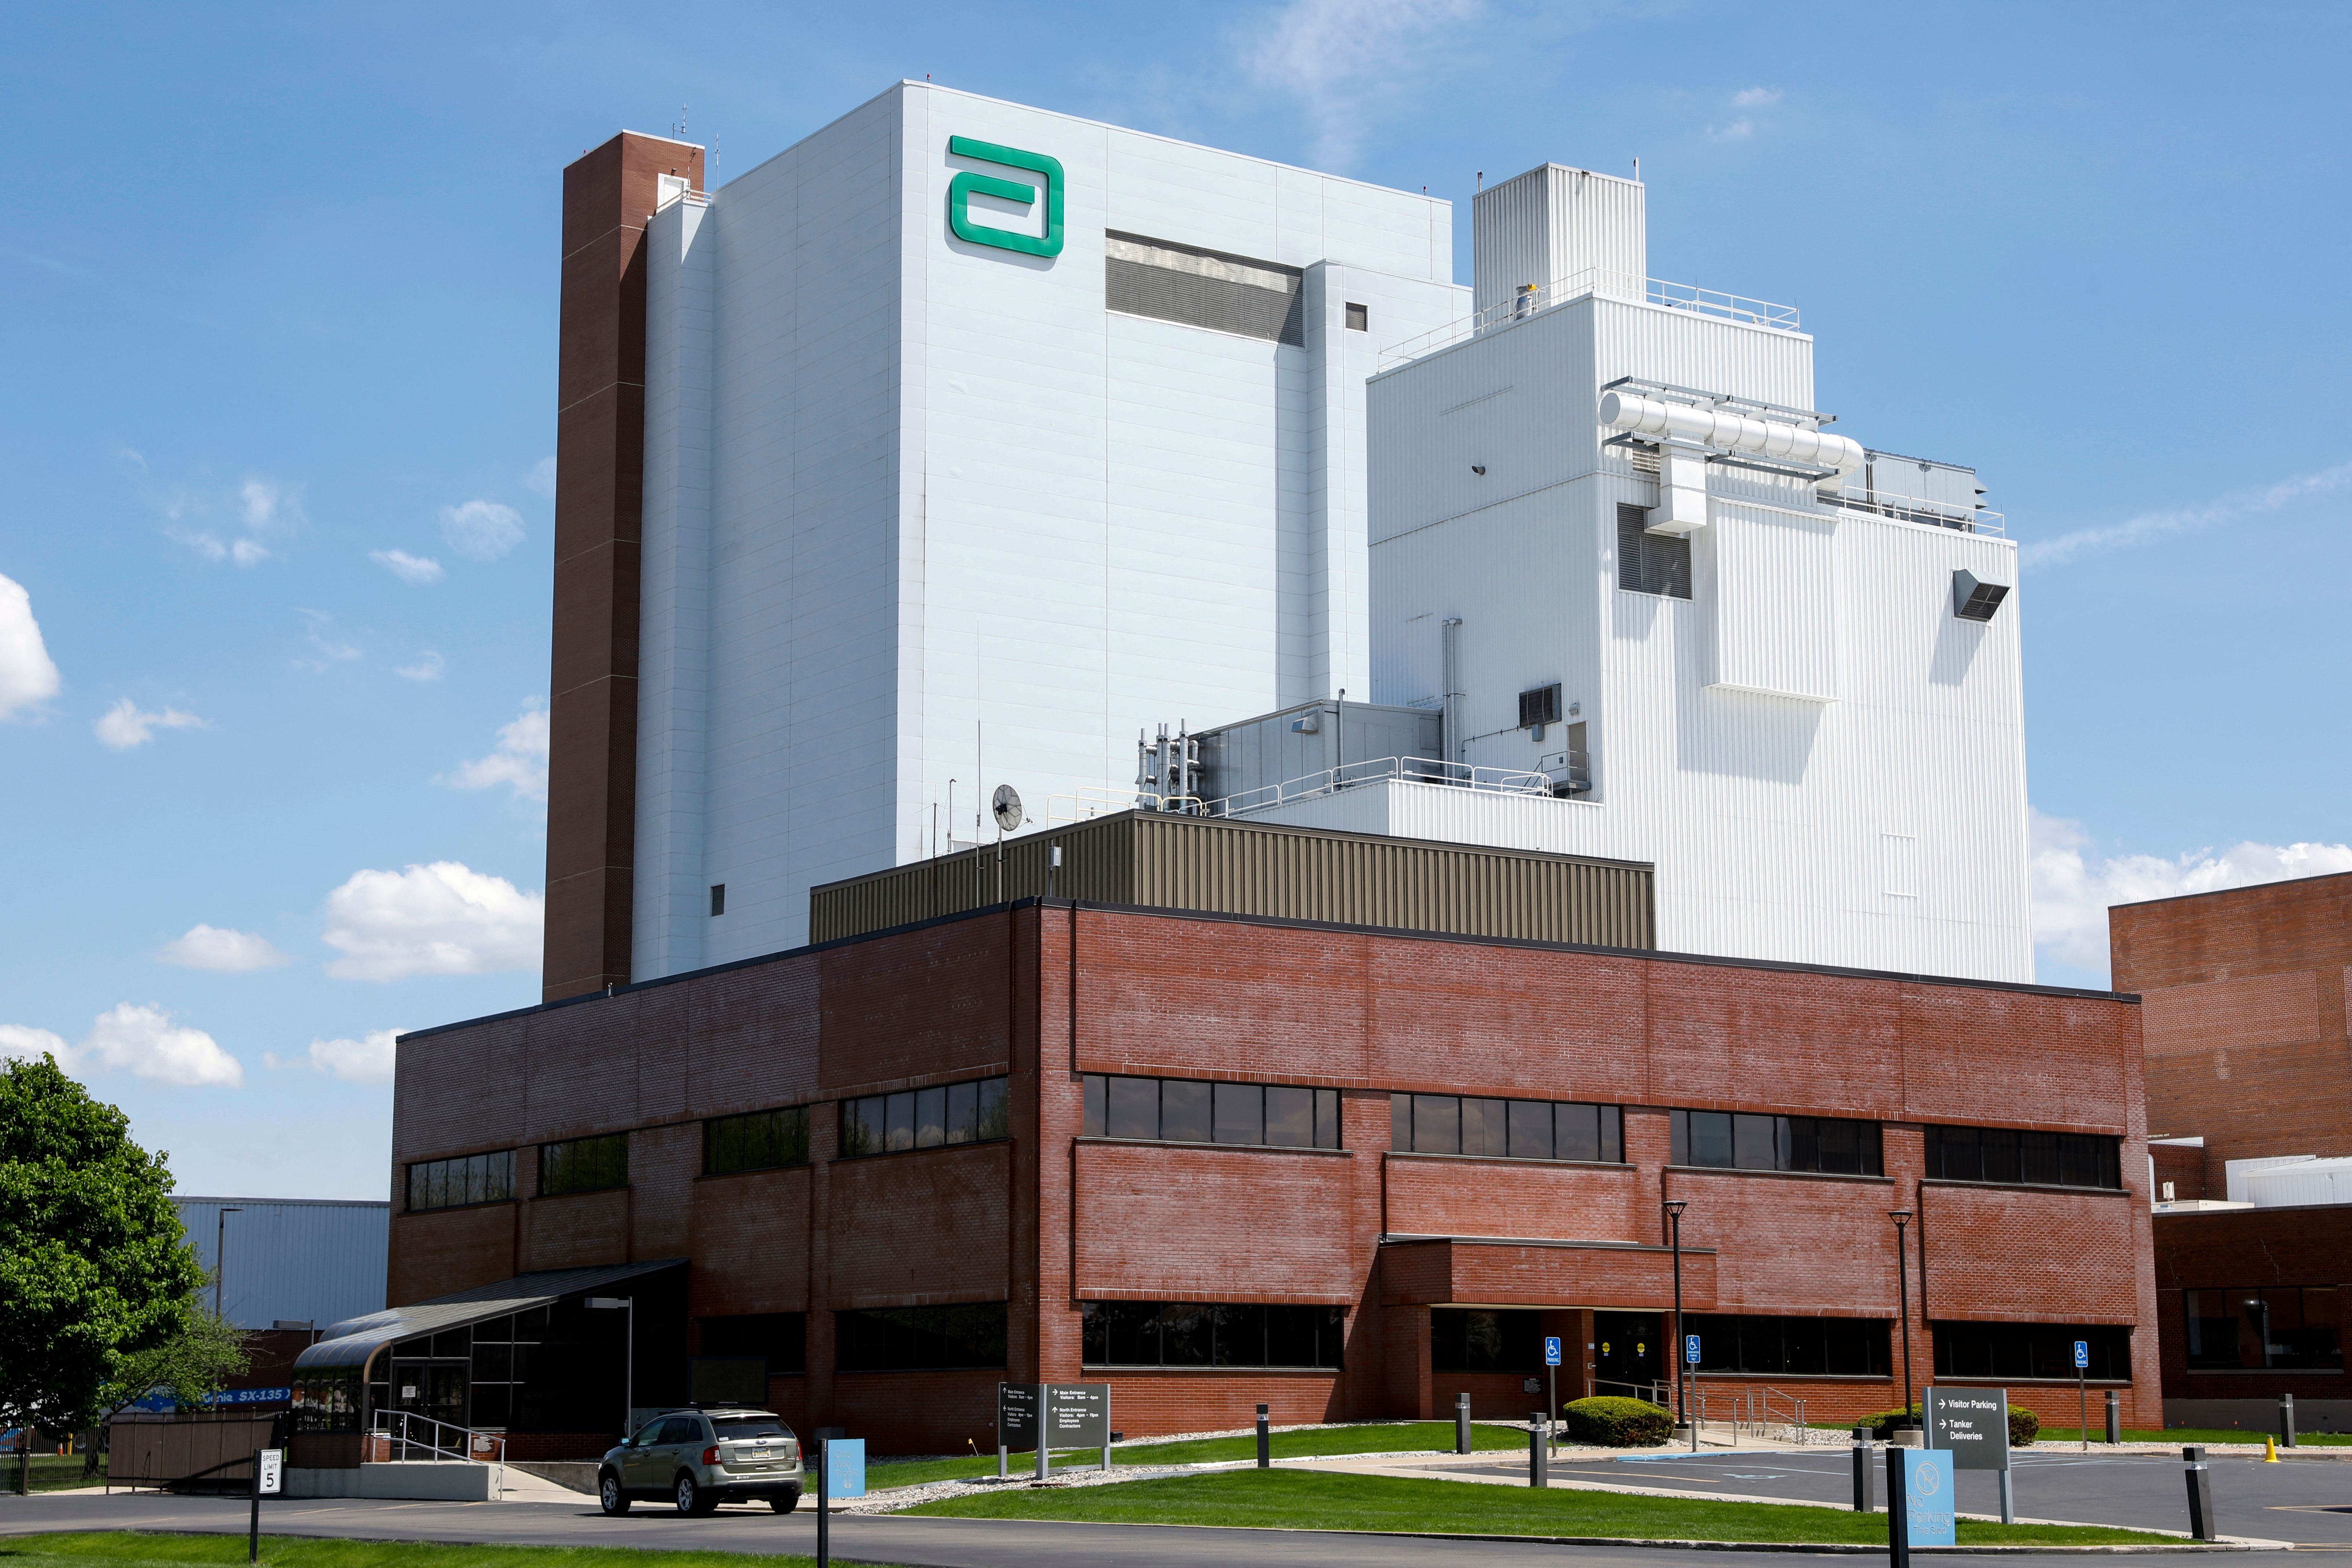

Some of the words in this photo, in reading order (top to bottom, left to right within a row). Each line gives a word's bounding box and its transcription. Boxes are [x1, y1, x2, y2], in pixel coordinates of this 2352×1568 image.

[239, 1389, 282, 1401] SX-135
[1948, 1399, 1970, 1408] Visitor
[1971, 1400, 1997, 1411] Parking
[1949, 1420, 1973, 1428] Tanker
[1950, 1431, 1983, 1440] Deliveries
[834, 1450, 851, 1459] One
[834, 1460, 851, 1469] Way
[834, 1469, 859, 1477] Traffic
[266, 1473, 274, 1487] 5
[1907, 1494, 1924, 1507] No
[1908, 1510, 1950, 1527] Parking
[1913, 1526, 1928, 1535] This
[1930, 1526, 1946, 1535] Side
